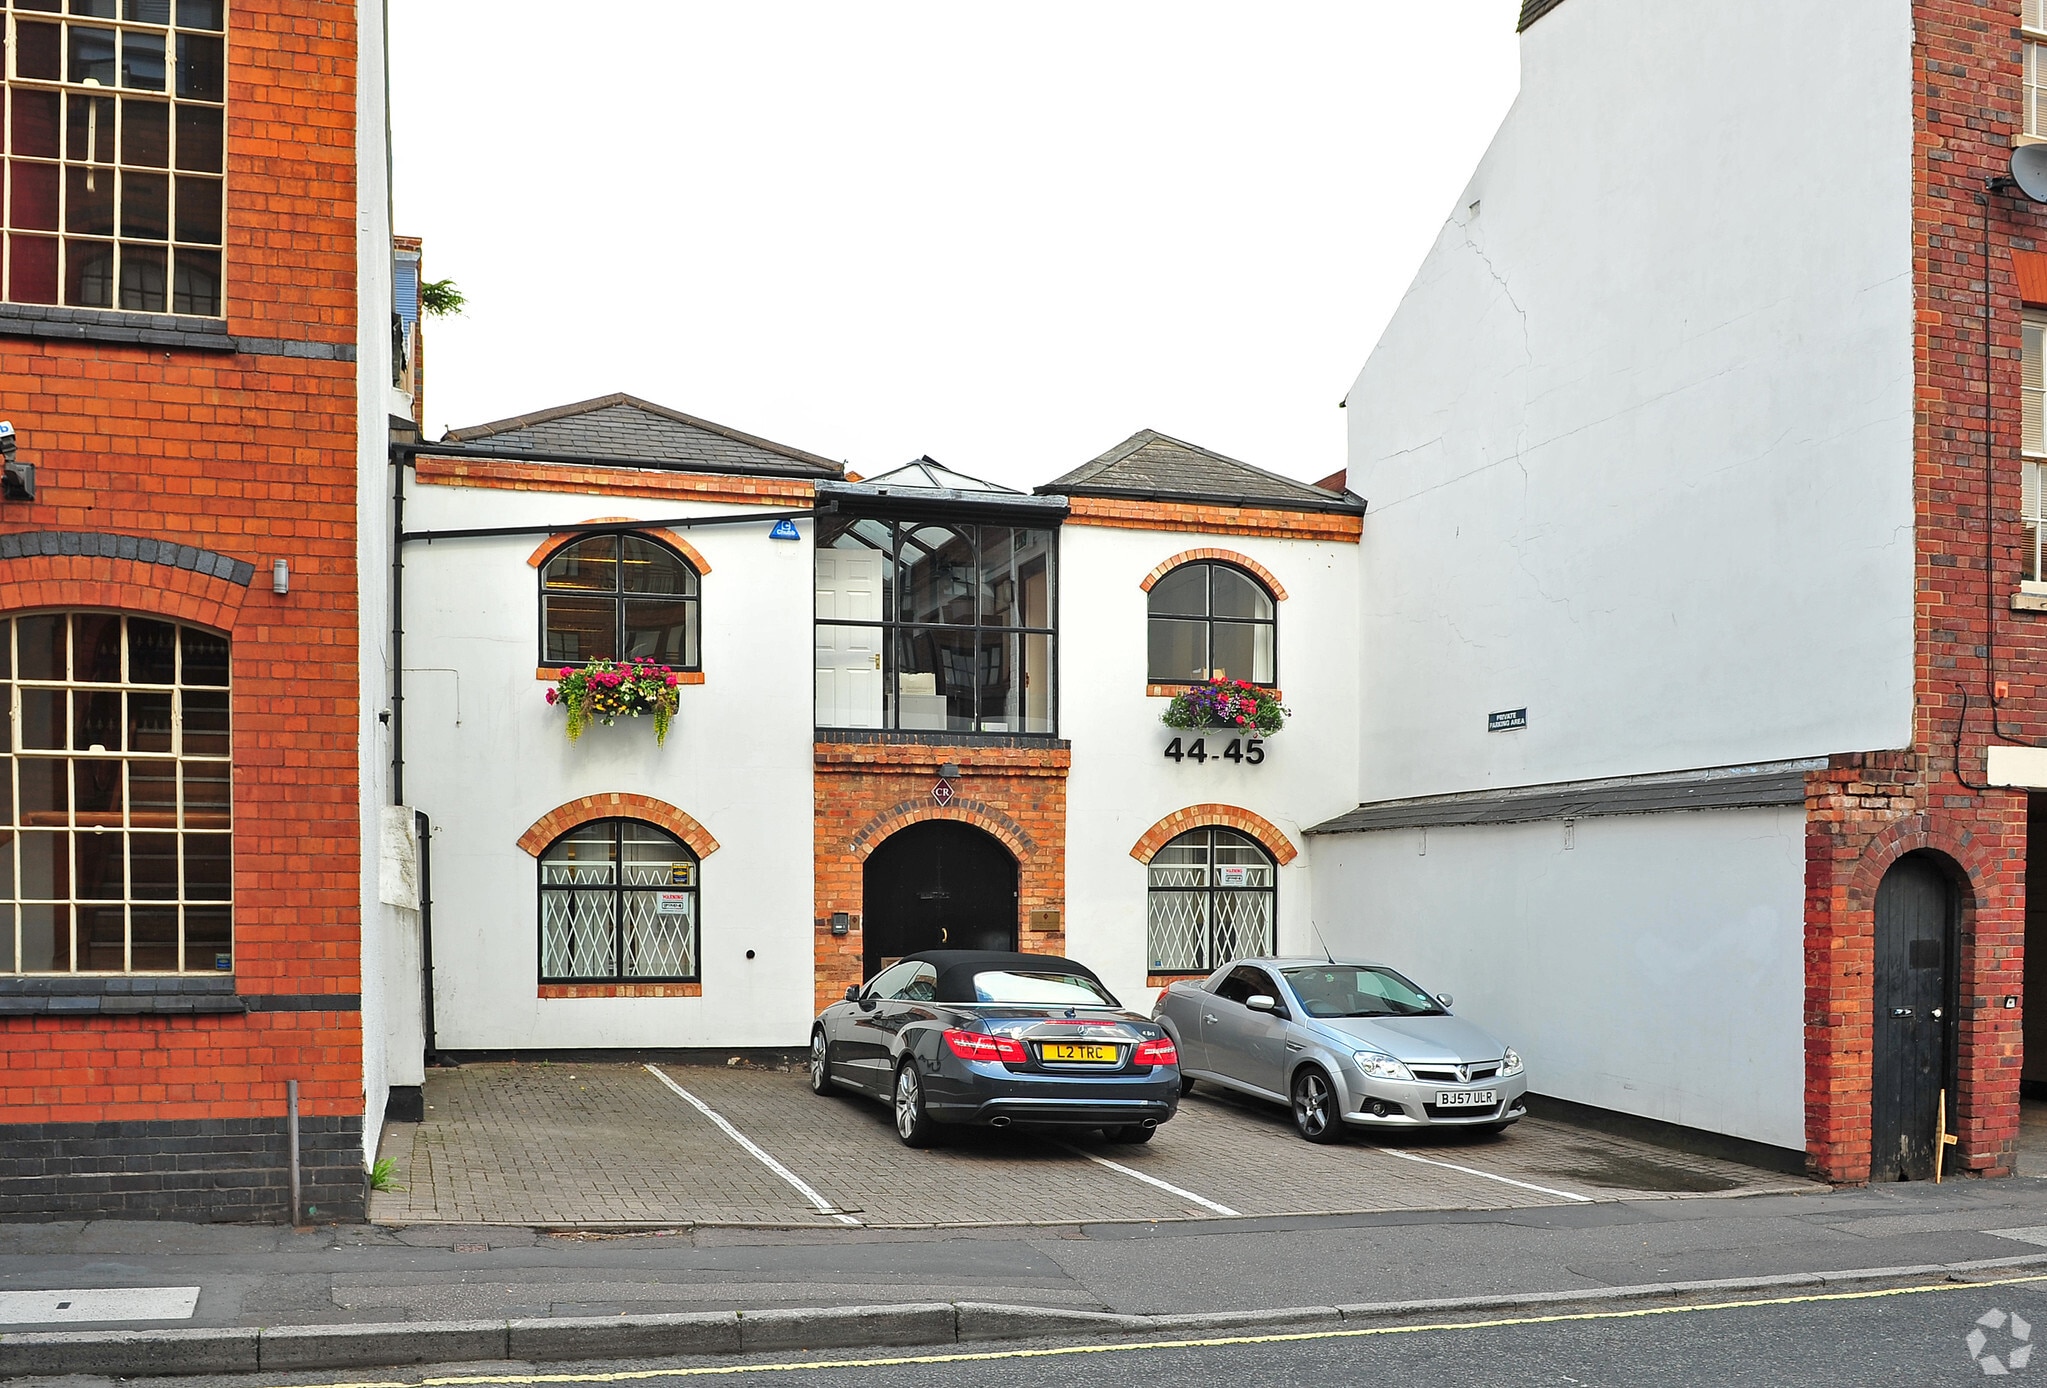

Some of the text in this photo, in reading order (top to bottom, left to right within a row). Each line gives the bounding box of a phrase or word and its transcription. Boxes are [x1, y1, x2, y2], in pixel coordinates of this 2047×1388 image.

[1496, 712, 1517, 721] PRIVATE
[1490, 717, 1525, 729] PARKING AREA
[935, 787, 950, 797] CR
[1057, 1045, 1103, 1059] L2 TRC
[1442, 1091, 1493, 1105] BJ57 ULR
